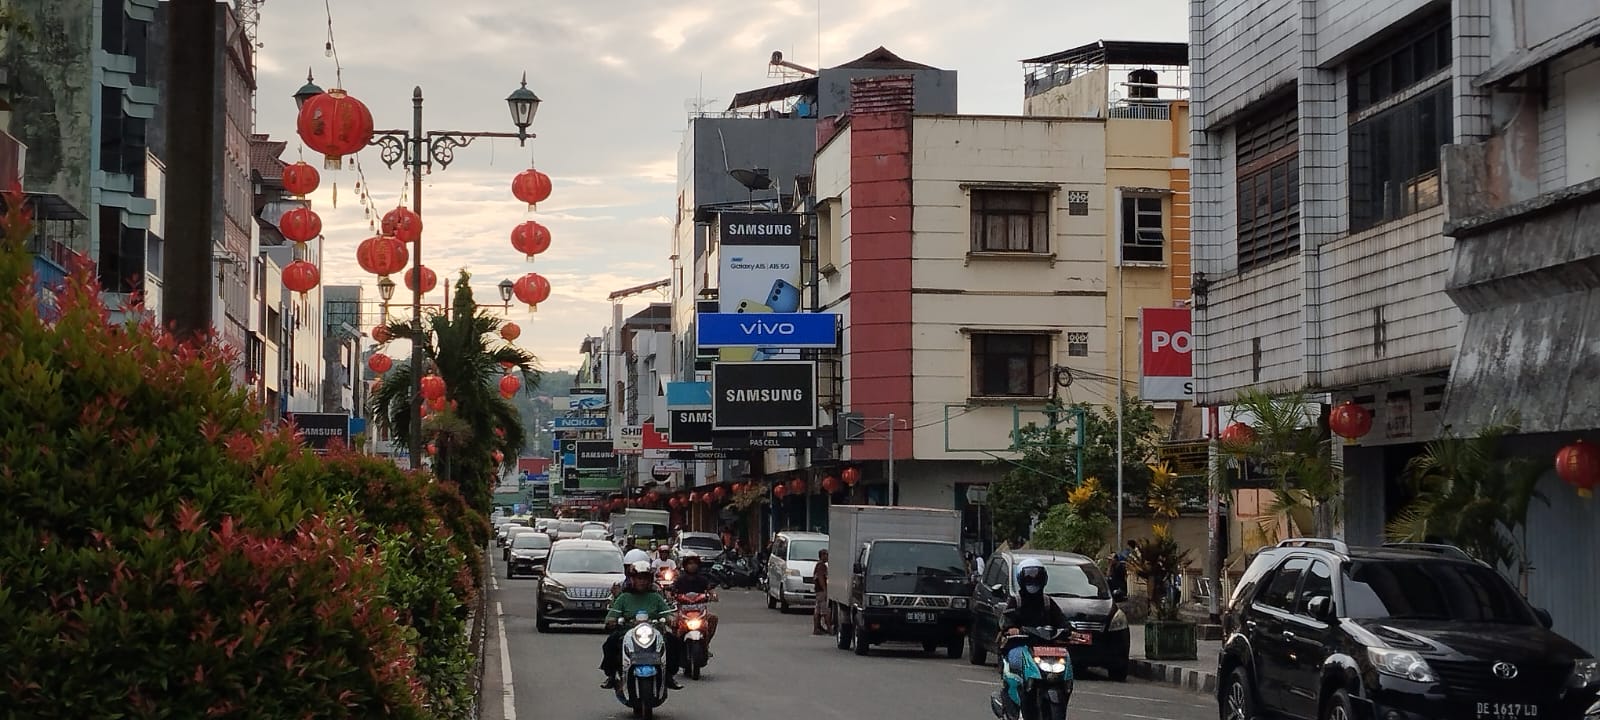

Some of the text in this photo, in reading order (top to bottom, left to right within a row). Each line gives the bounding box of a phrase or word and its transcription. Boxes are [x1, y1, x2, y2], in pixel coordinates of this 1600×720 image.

[729, 224, 792, 235] SAMSUNG
[730, 263, 755, 271] Galaxy
[740, 319, 795, 335] vivo
[726, 389, 802, 402] SAMSUNG
[300, 427, 343, 436] SAMSUNG
[750, 439, 780, 447] PAS CELL
[1477, 702, 1538, 716] DE 1617 LD
